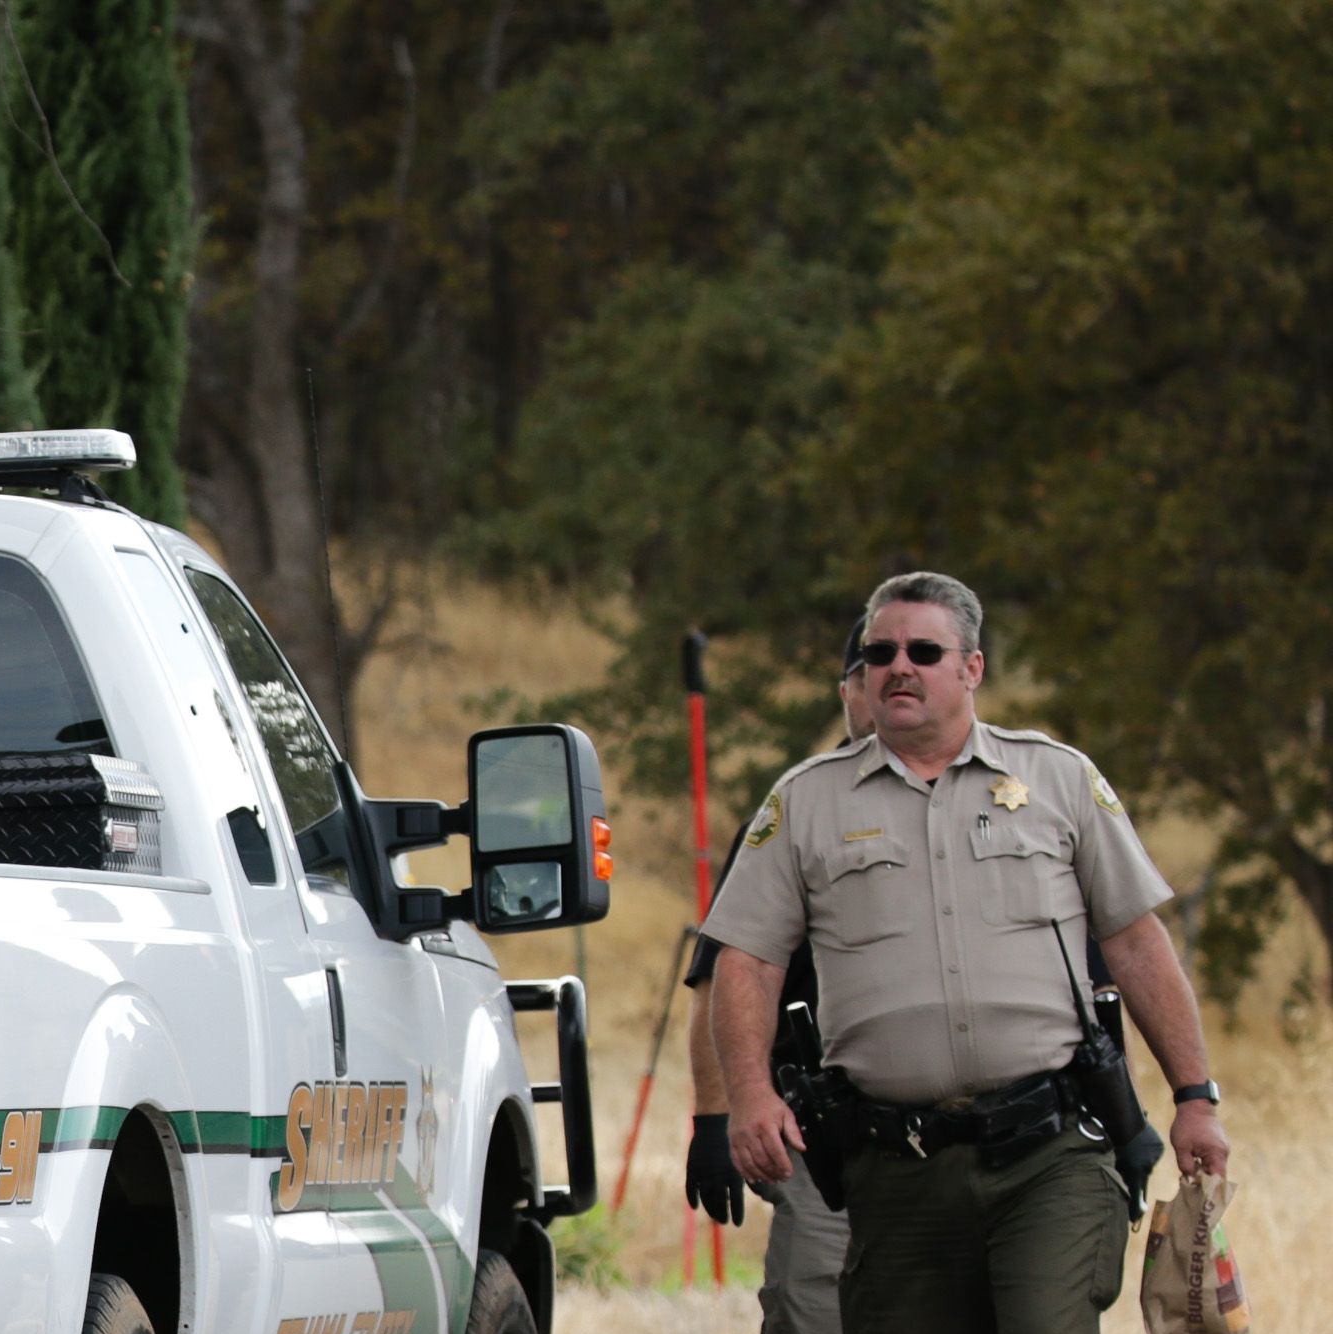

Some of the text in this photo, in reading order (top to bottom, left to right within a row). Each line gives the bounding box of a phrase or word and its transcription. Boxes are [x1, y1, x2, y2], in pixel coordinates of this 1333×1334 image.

[278, 1081, 408, 1211] SHERIFF
[1188, 1201, 1215, 1324] BURGER KING
